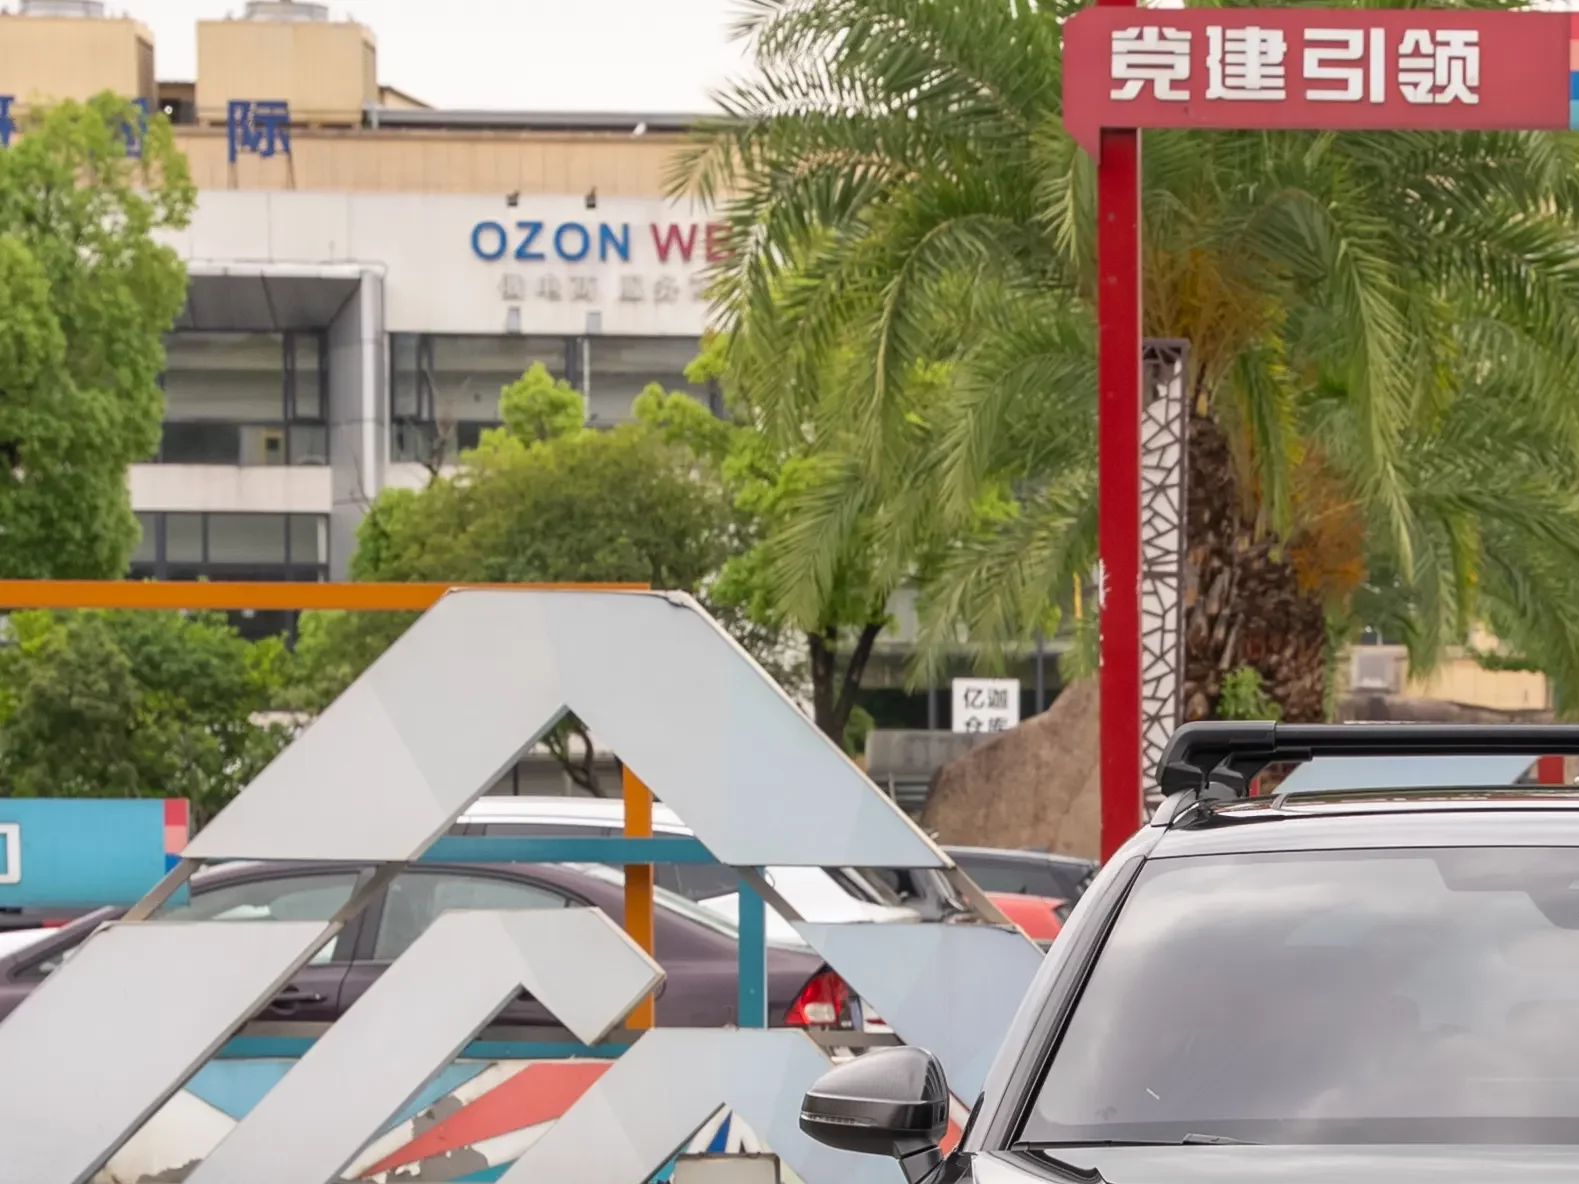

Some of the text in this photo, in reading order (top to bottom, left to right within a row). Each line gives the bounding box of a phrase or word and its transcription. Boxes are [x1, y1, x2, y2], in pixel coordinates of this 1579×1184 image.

[1109, 25, 1480, 104] 党建引领
[470, 220, 631, 262] OZON
